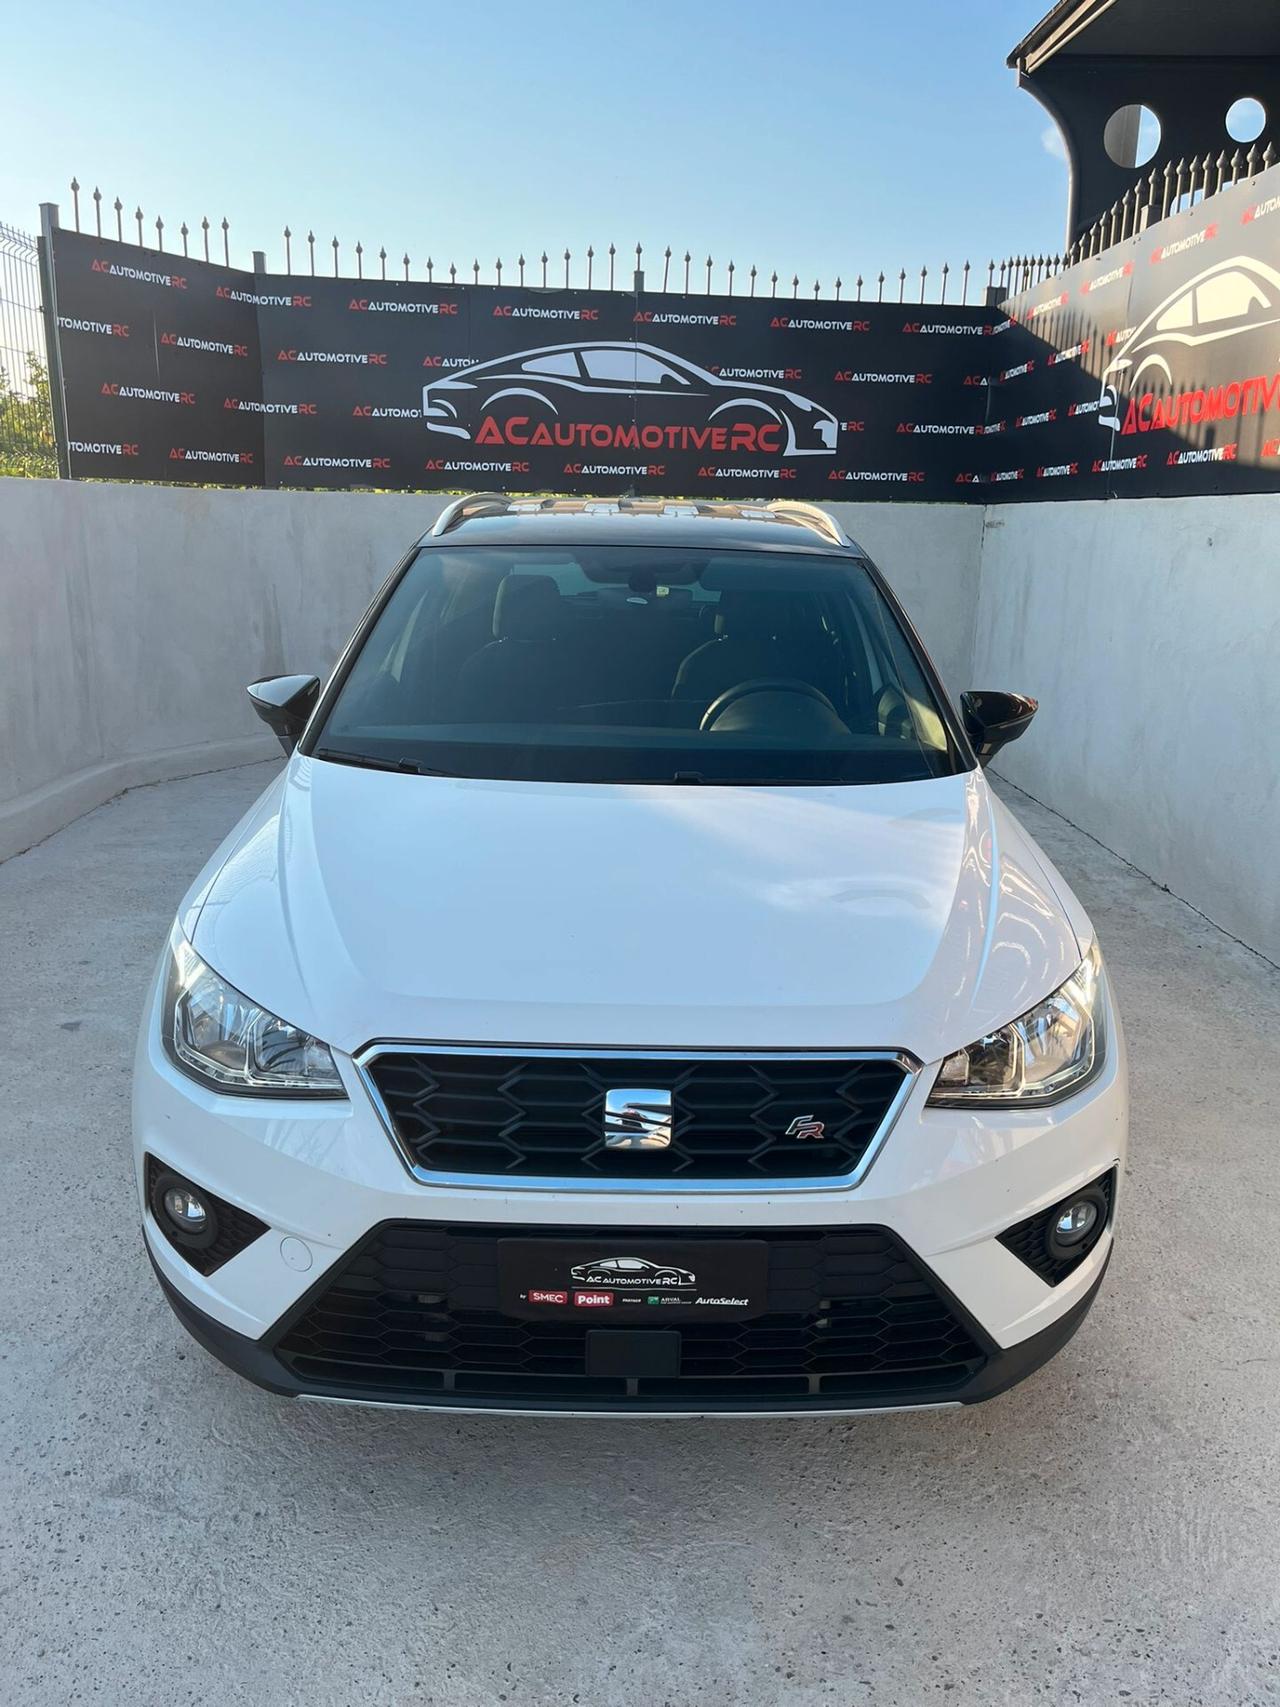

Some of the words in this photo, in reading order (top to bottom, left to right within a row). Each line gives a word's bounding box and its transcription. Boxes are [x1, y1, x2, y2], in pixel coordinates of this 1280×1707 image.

[91, 258, 187, 290] ACAUTOMOTIVERC
[215, 286, 311, 308] ACAUTOMOTIVERC
[349, 298, 458, 315] ACAUTOMOTIVERC
[493, 305, 599, 321] ACAUTOMOTIVERC
[633, 311, 736, 325] ACAUTOMOTIVERC
[770, 316, 870, 331] ACAUTOMOTIVERC
[902, 322, 993, 336] ACAUTOMOTIVER
[160, 332, 248, 357] ACAUTOMOTIVERC
[278, 349, 387, 366] ACAUTOMOTIVERC
[834, 370, 932, 385] ACAUTOMOTIVERC
[101, 382, 195, 405] ACAUTOMOTIVERC
[223, 397, 317, 415] ACAUTOMOTIVERC
[475, 416, 783, 452] ACAUTOMOTIVERC
[896, 423, 984, 436] ACAUTOMOTIVER
[169, 448, 254, 464] ACAUTOMOTIVERC
[283, 455, 391, 469] ACAUTOMOTIVERC
[1166, 443, 1238, 466] ACAUTOMOTIVERC
[425, 459, 529, 473] ACAUTOMOTIVERC
[563, 463, 665, 476] ACAUTOMOTIVERC
[1090, 454, 1148, 472] ACAUTOMOTIVERC
[697, 466, 797, 480] ACAUTOMOTIVERC
[828, 470, 925, 483] ACAUTOMOTIVERC
[785, 1114, 825, 1139] FR
[533, 1292, 563, 1303] SMEC
[578, 1295, 610, 1305] Point
[695, 1297, 749, 1306] AutoSelect
